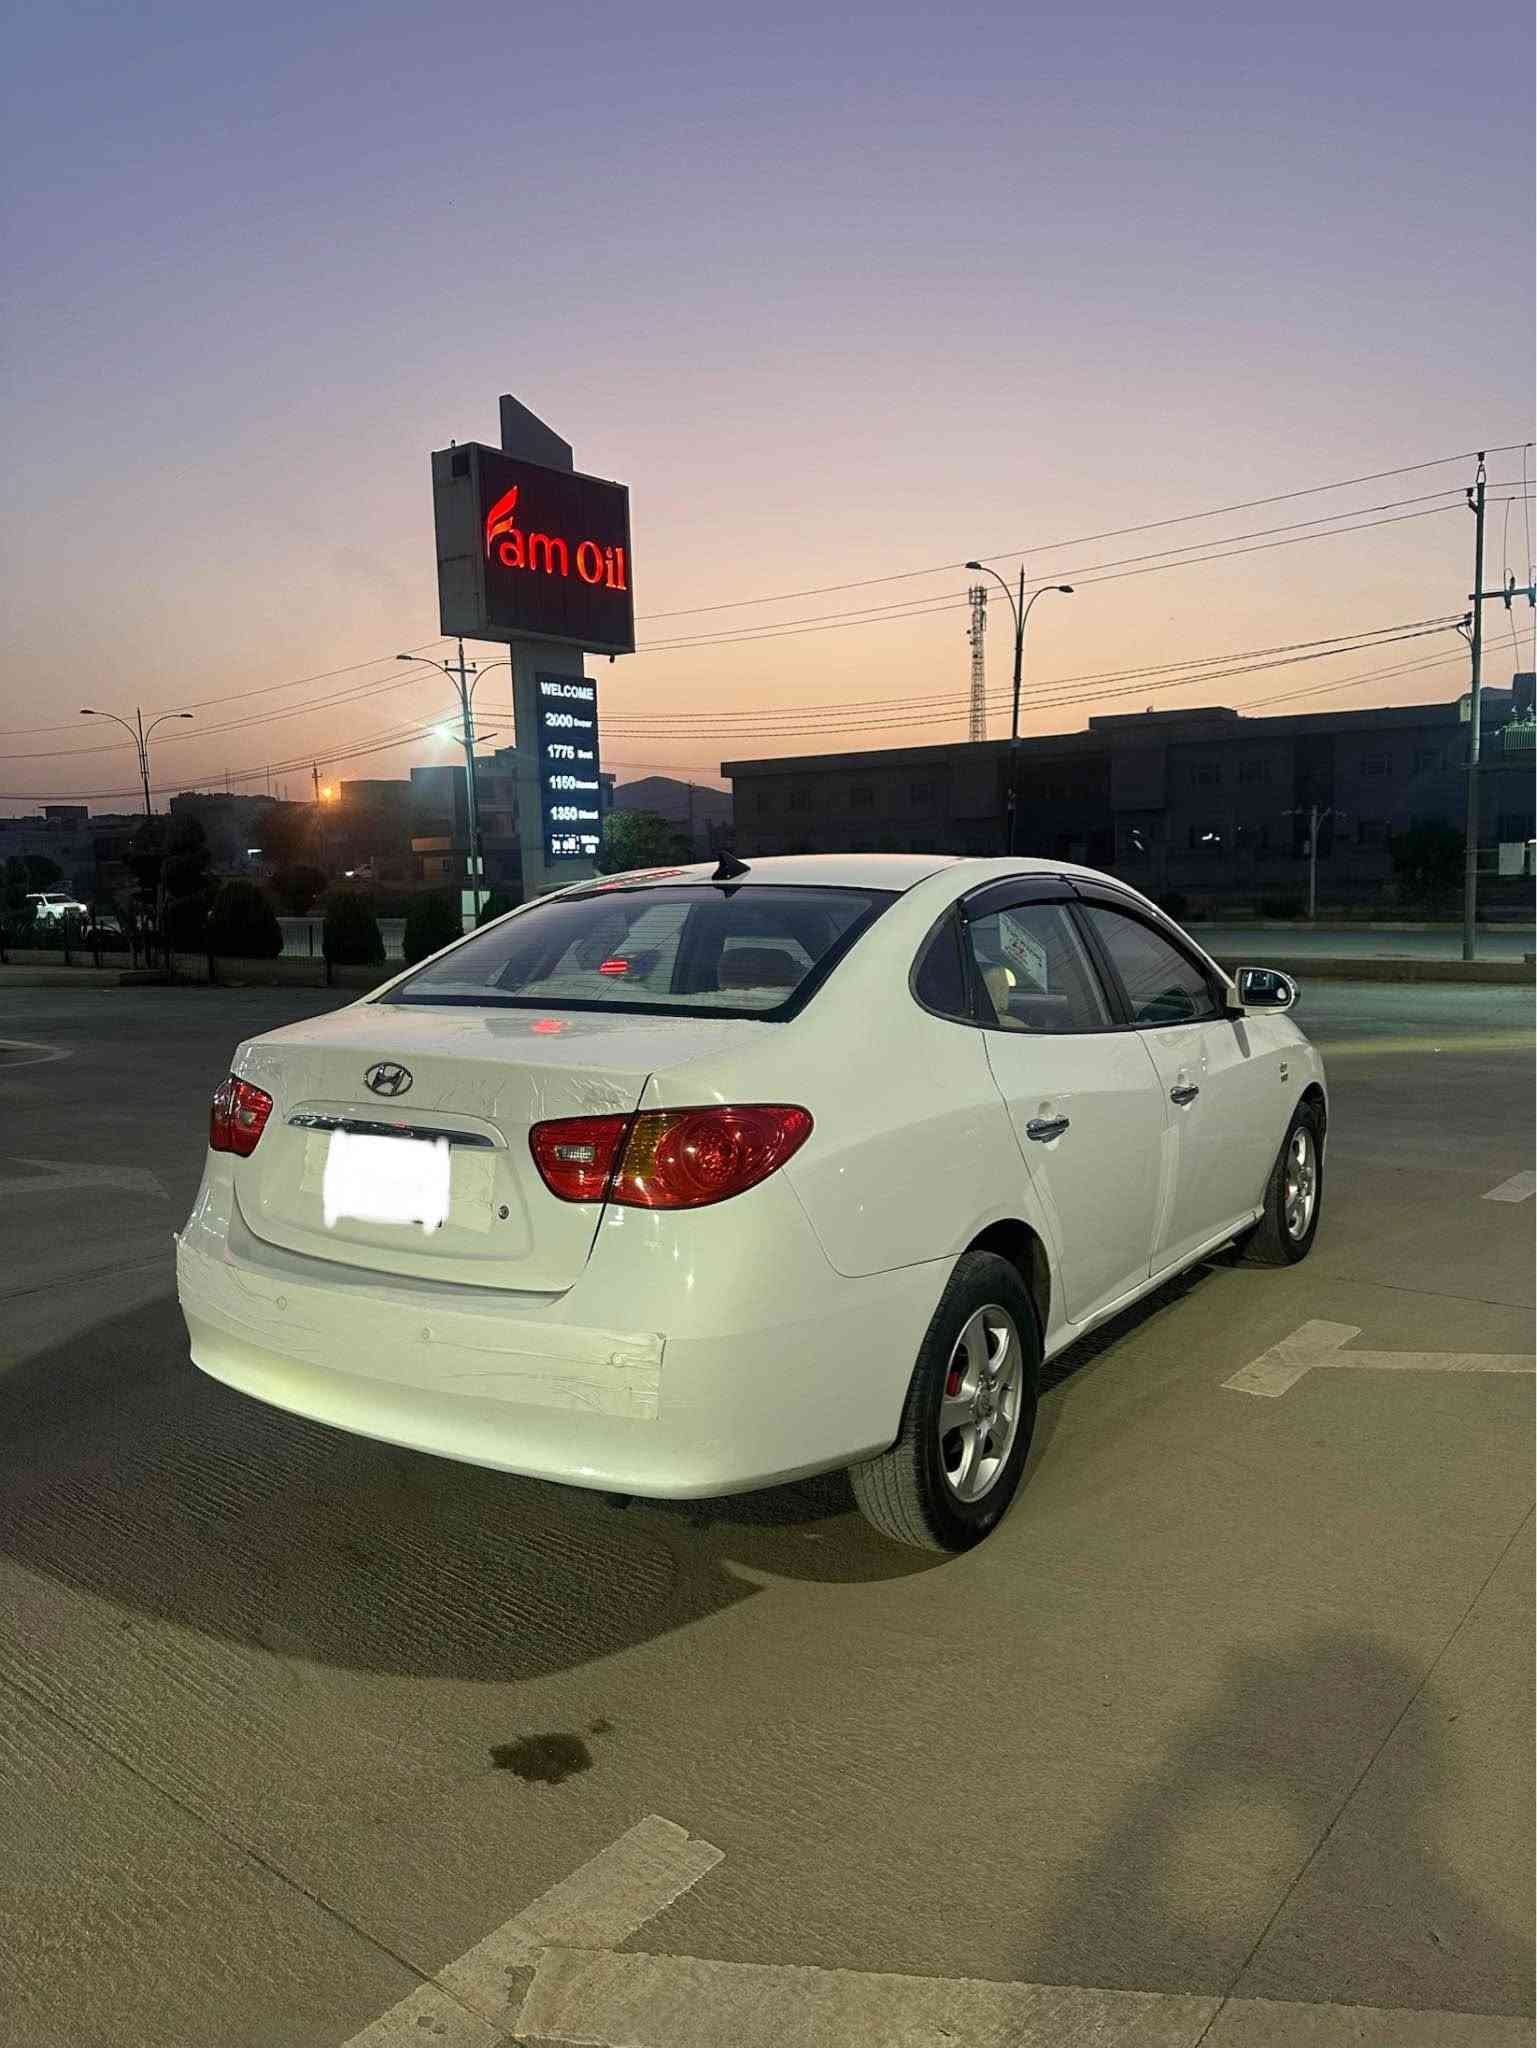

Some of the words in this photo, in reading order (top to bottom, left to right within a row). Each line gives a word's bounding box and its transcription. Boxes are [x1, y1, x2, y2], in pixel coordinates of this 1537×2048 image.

[577, 540, 627, 590] Oil
[540, 682, 594, 701] WELCOME
[545, 712, 573, 728] 2000
[547, 744, 575, 760] 1775
[549, 775, 576, 790] 1150
[550, 806, 577, 821] 1350
